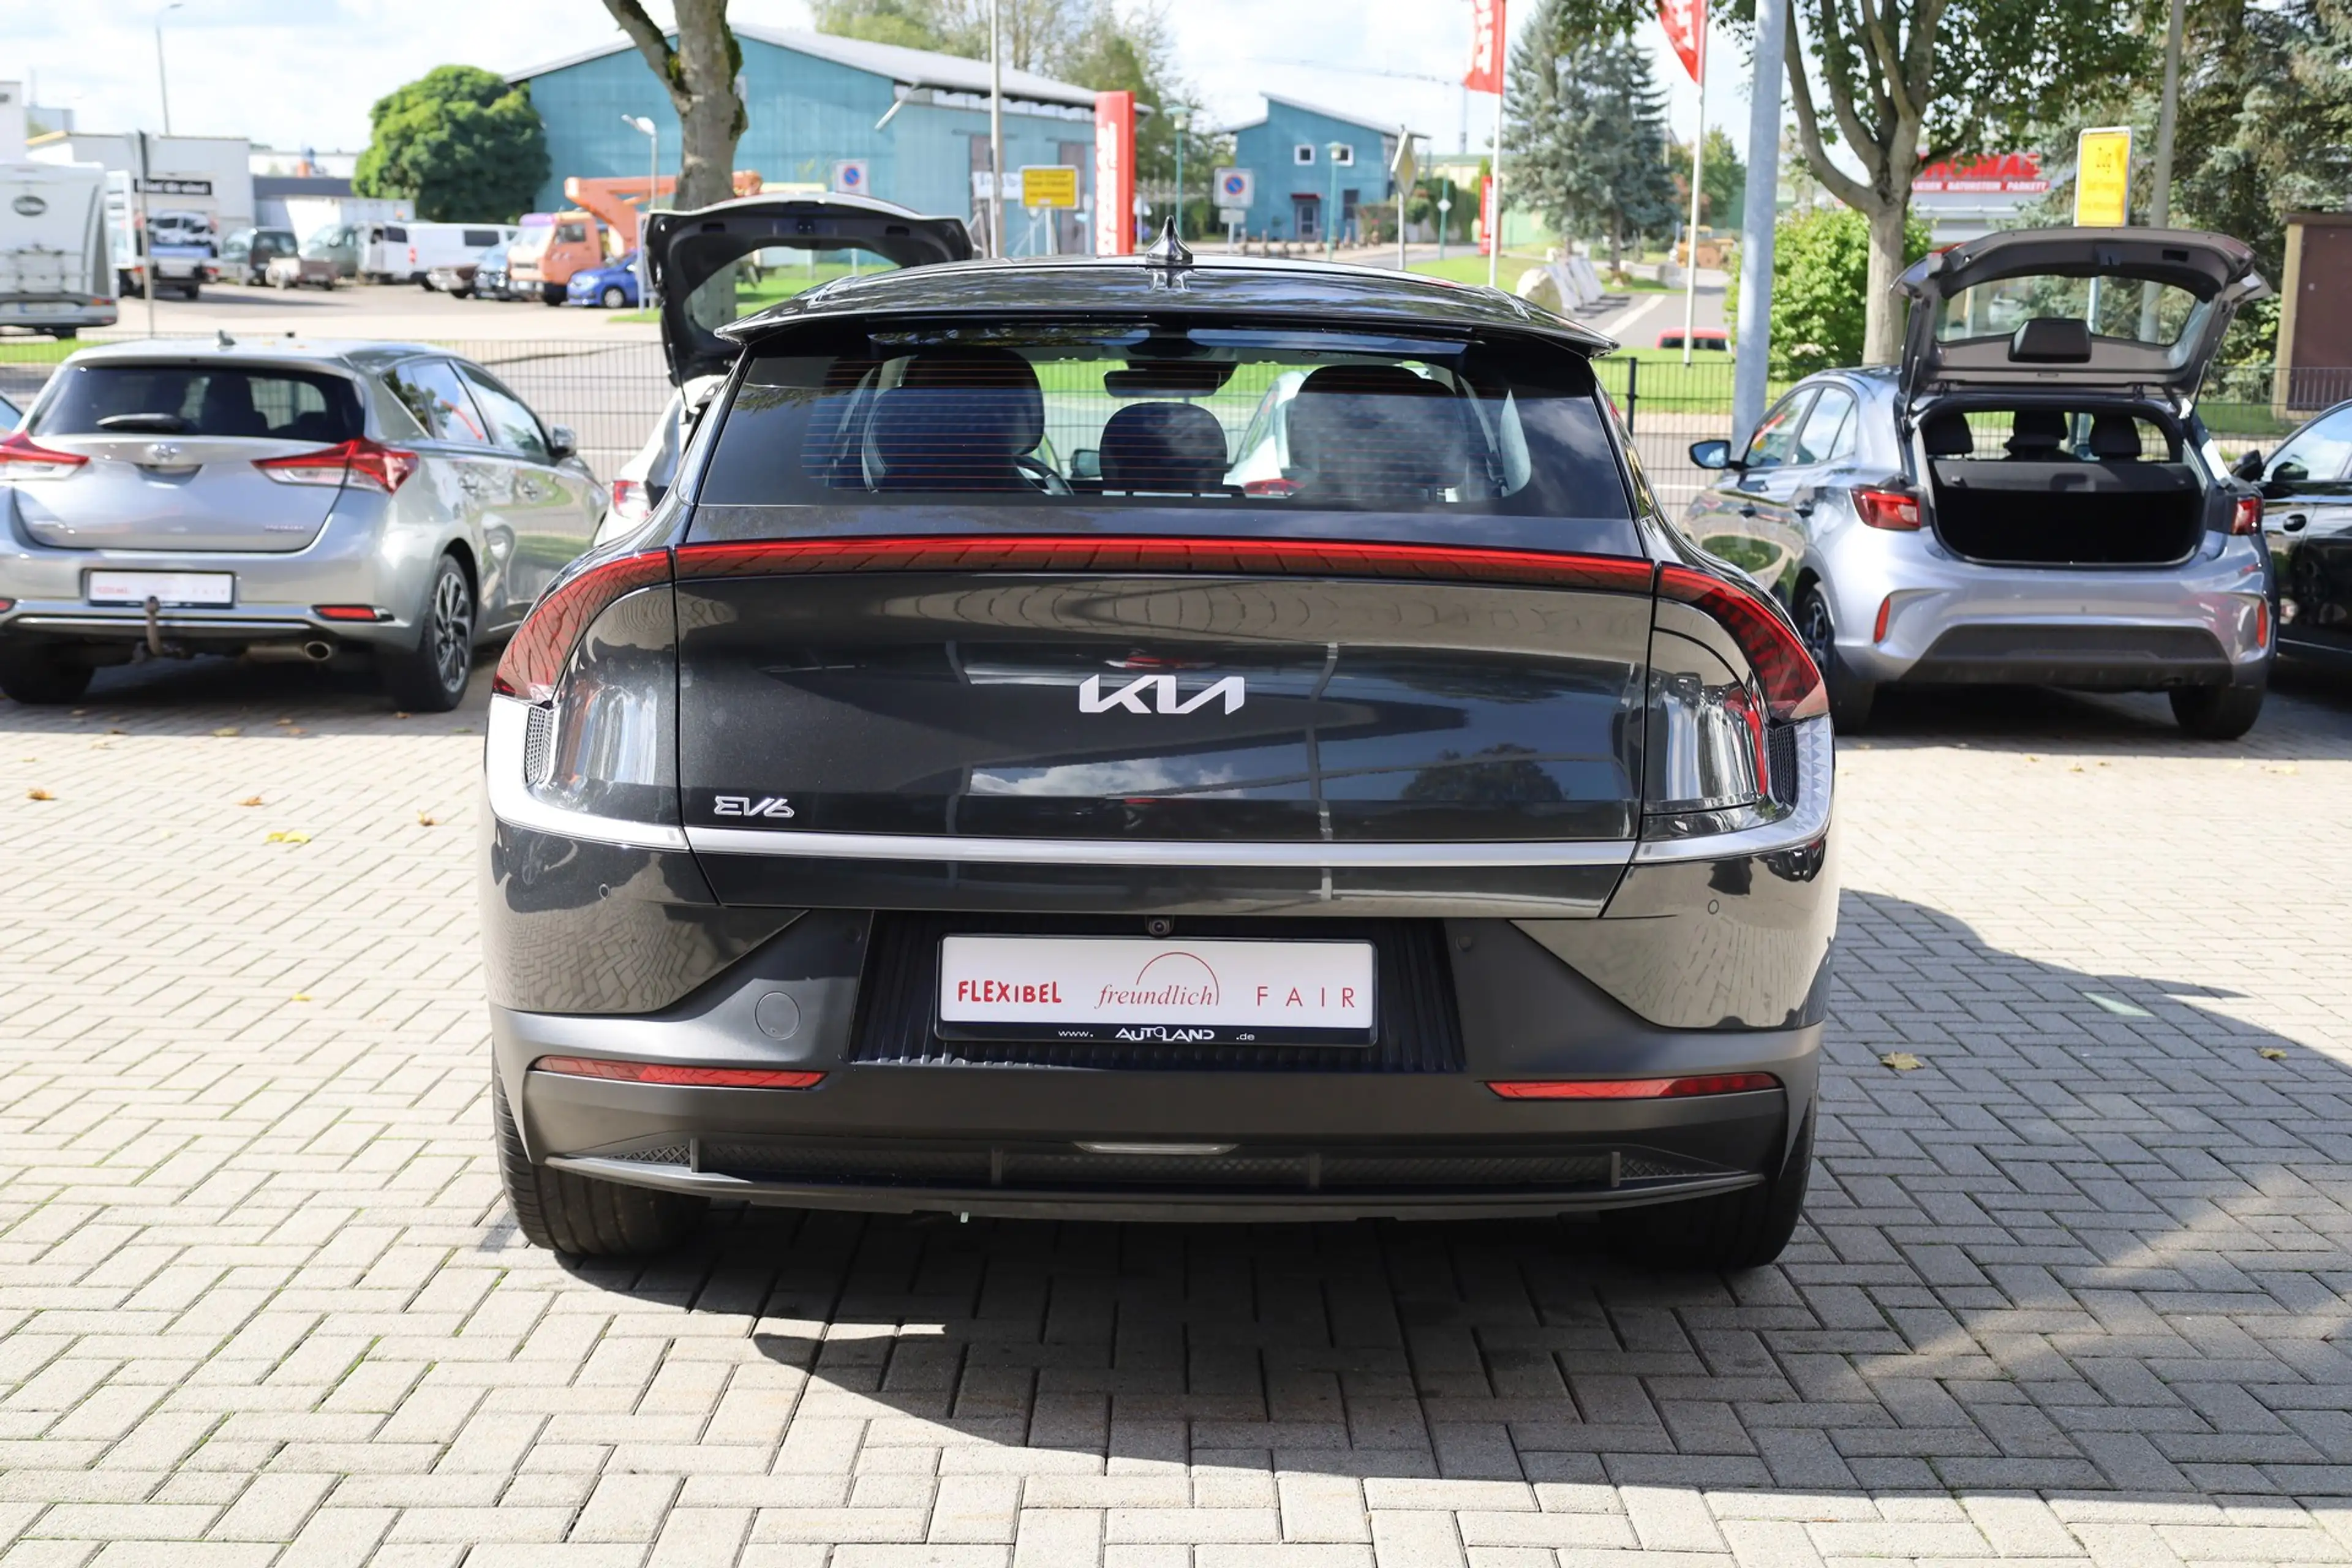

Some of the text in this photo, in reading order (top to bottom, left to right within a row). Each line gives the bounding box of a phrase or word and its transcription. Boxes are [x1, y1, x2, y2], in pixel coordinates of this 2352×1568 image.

[1079, 674, 1245, 715] KIA
[714, 796, 795, 818] EV6
[958, 979, 1355, 1009] FLEXIBEL freundlich FAIR
[1115, 1027, 1215, 1042] AUTOLAND
